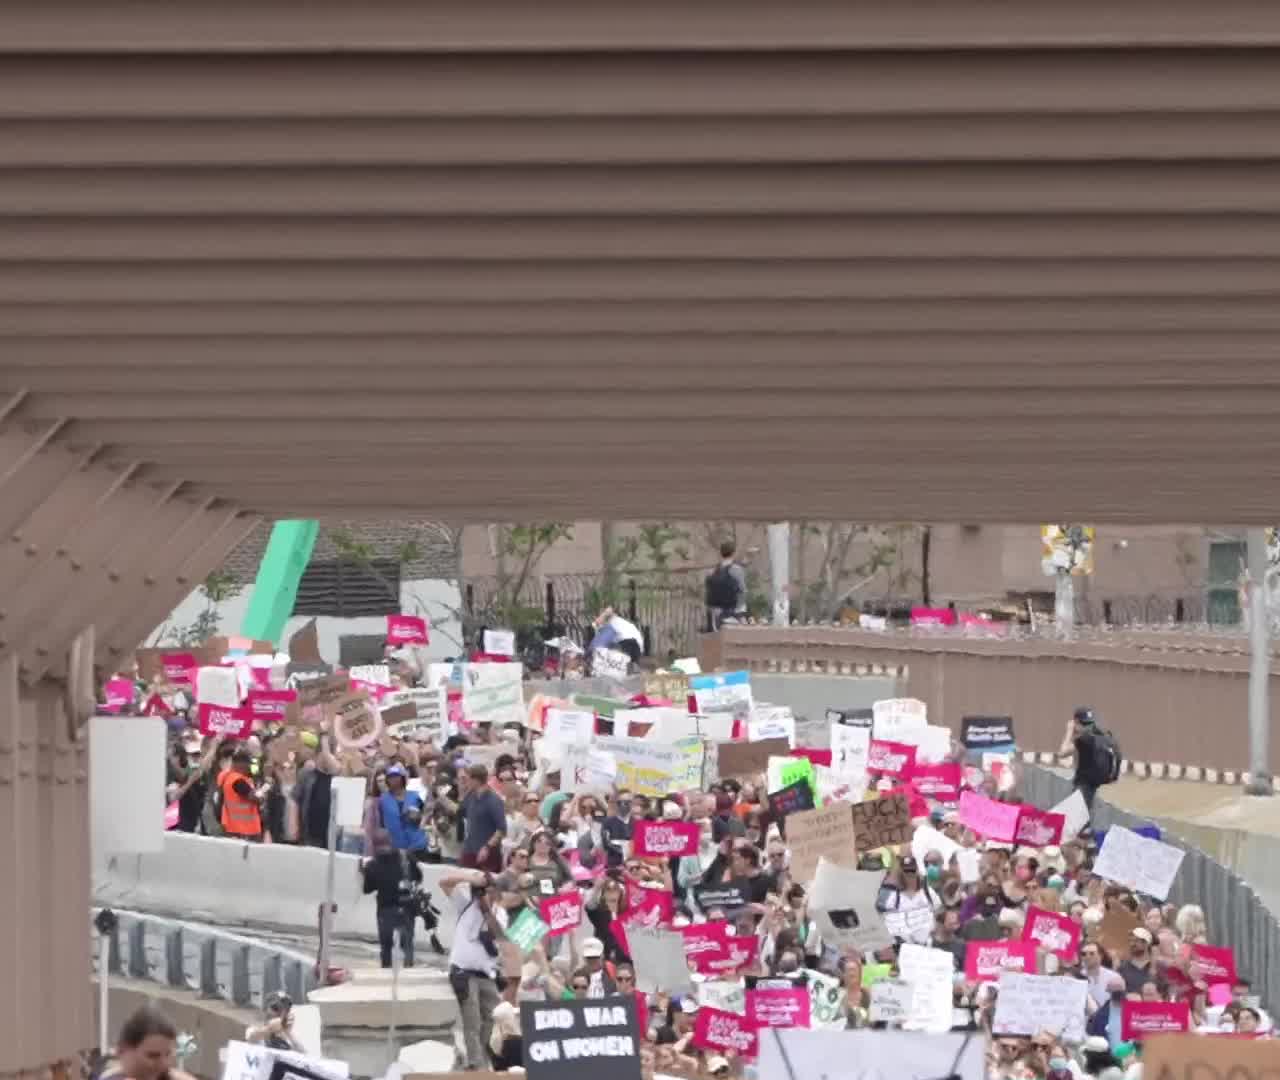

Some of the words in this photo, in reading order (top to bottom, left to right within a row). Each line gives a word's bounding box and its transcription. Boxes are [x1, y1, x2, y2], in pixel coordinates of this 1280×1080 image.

[534, 1008, 574, 1030] END
[583, 1005, 627, 1028] WAR
[528, 1040, 560, 1062] ON
[561, 1035, 635, 1059] WOMEN
